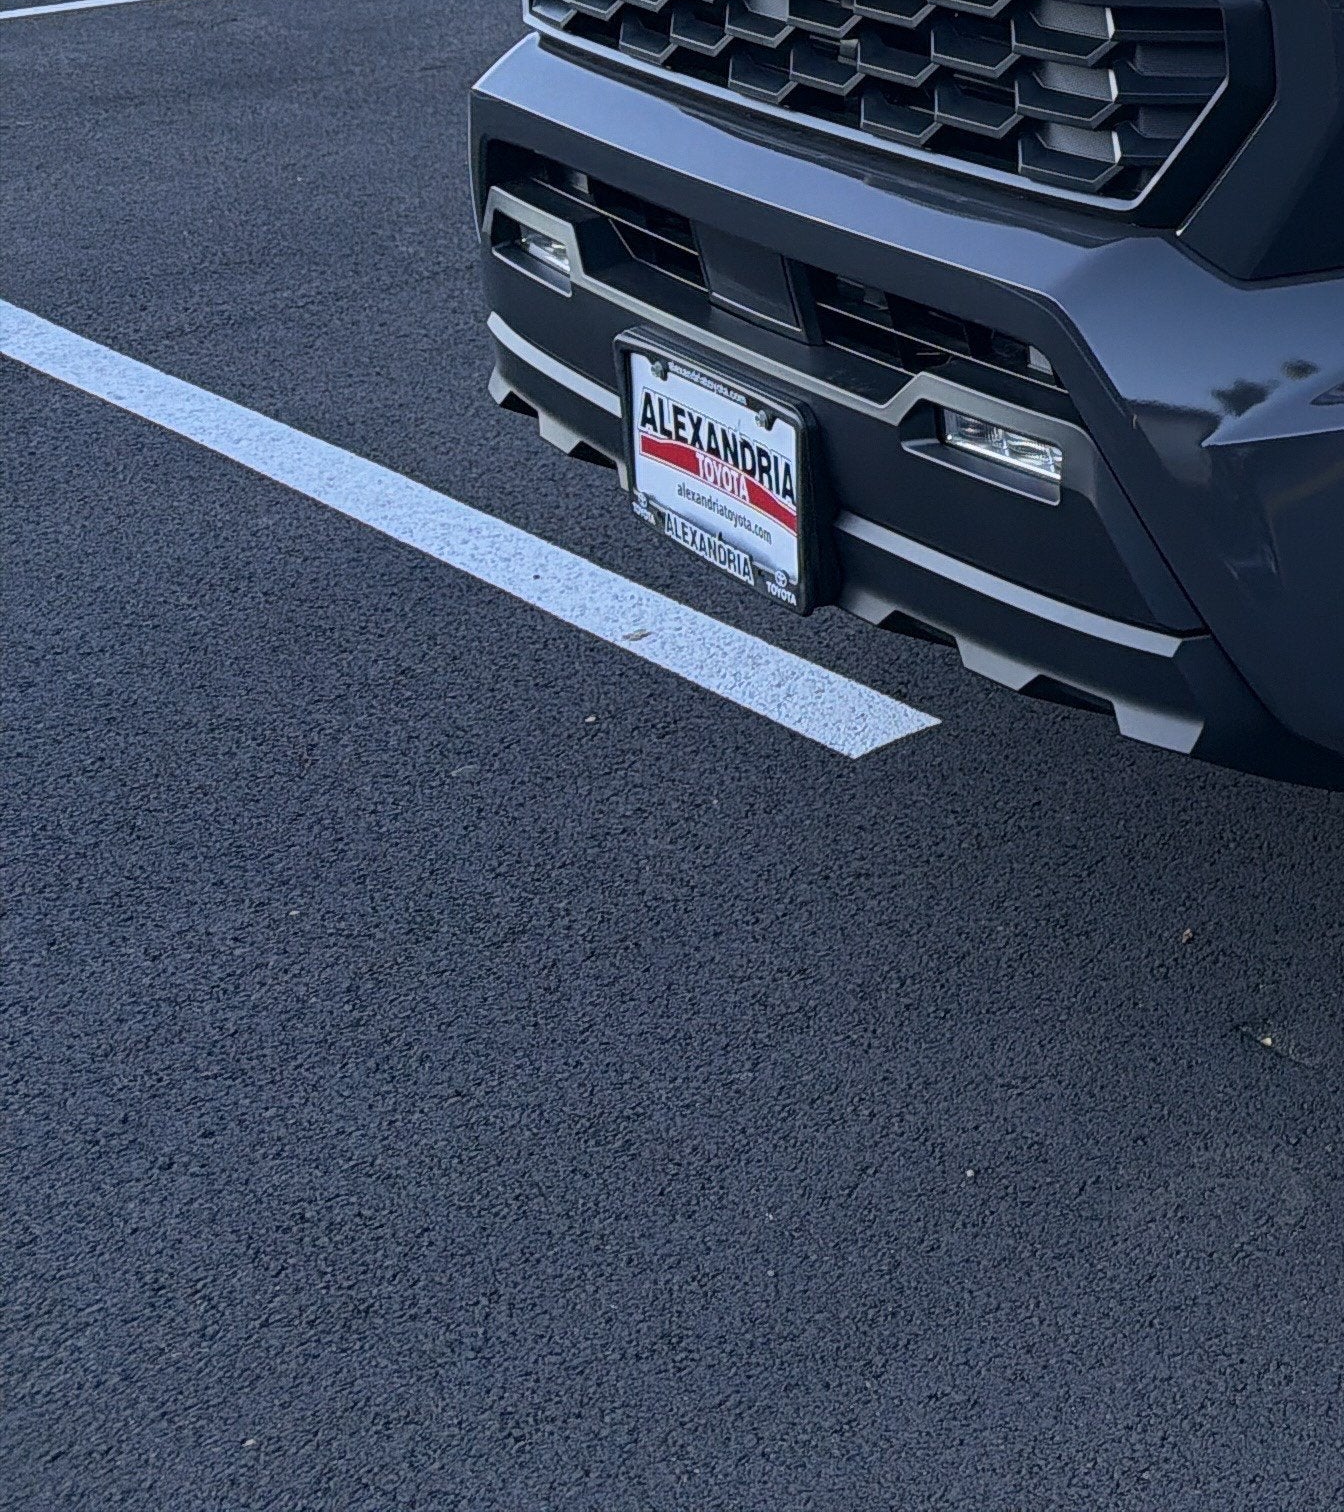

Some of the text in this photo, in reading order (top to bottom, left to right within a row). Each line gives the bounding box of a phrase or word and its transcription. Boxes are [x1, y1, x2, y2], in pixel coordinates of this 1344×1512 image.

[640, 392, 796, 504] ALEXANDRIA
[695, 452, 751, 503] TOYOTA
[677, 481, 772, 545] alexandriatoyota.com
[665, 513, 754, 585] ALEXANDRIA
[766, 580, 797, 606] TOYOTA
